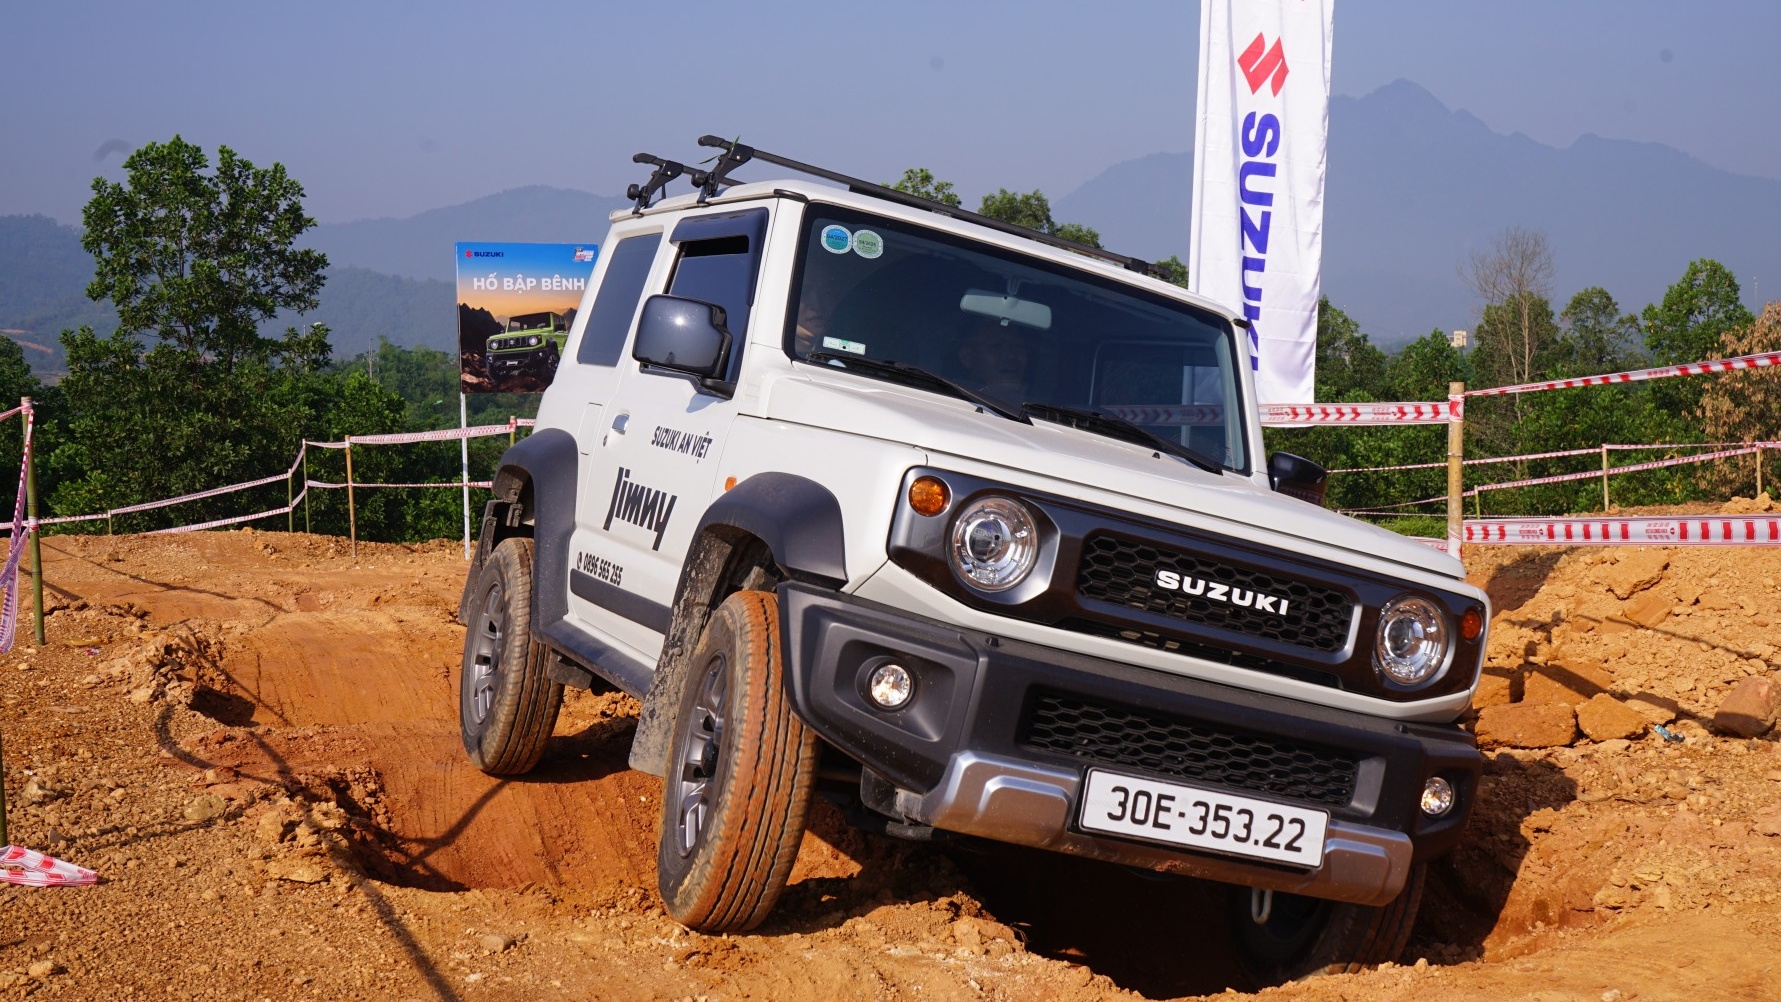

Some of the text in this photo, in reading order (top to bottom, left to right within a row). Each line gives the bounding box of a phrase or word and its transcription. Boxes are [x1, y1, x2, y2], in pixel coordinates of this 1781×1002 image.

[473, 272, 585, 294] HỐ BẬP BÊNH
[651, 425, 713, 464] SUZUKI AN VIỆT
[603, 466, 678, 552] Jimny
[583, 552, 624, 587] 0896 565 255
[1156, 570, 1289, 616] SUZUKI
[1107, 786, 1306, 852] 30E-353.22
